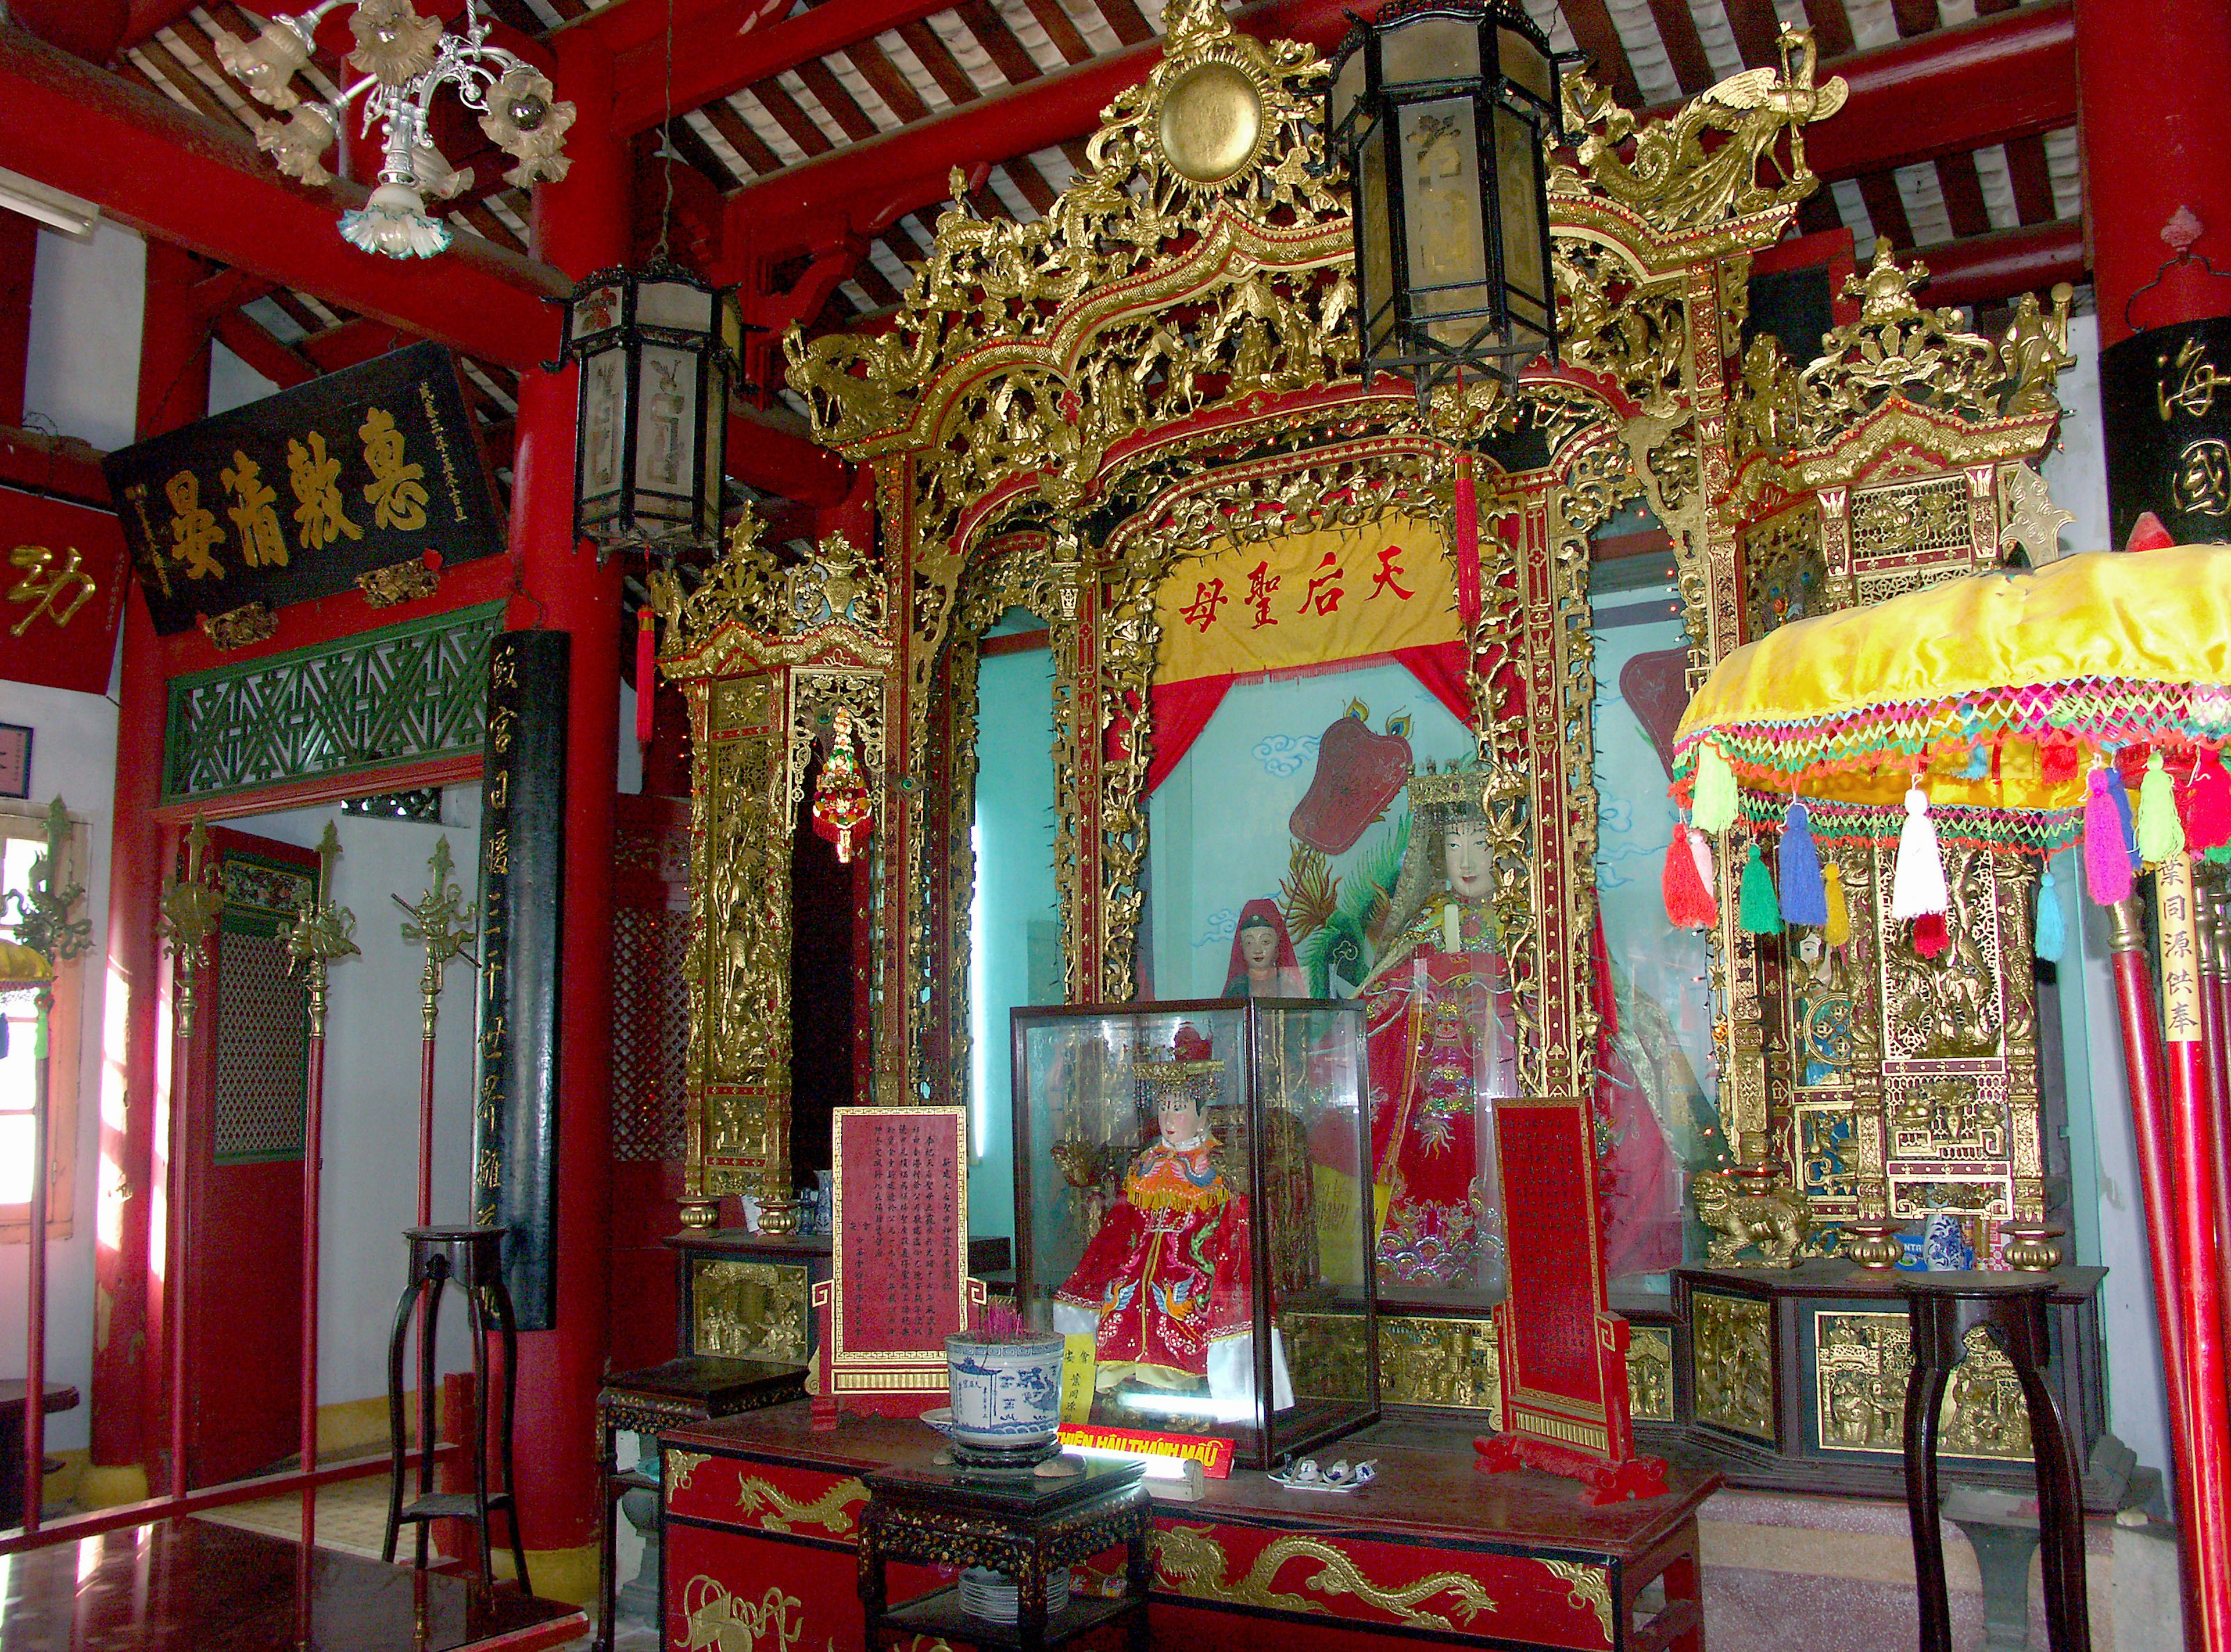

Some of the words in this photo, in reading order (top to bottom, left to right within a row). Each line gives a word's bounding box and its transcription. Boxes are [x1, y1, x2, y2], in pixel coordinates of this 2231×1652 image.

[1178, 544, 1416, 634] 天后聖母
[2157, 858, 2198, 1036] 葉同源供奉
